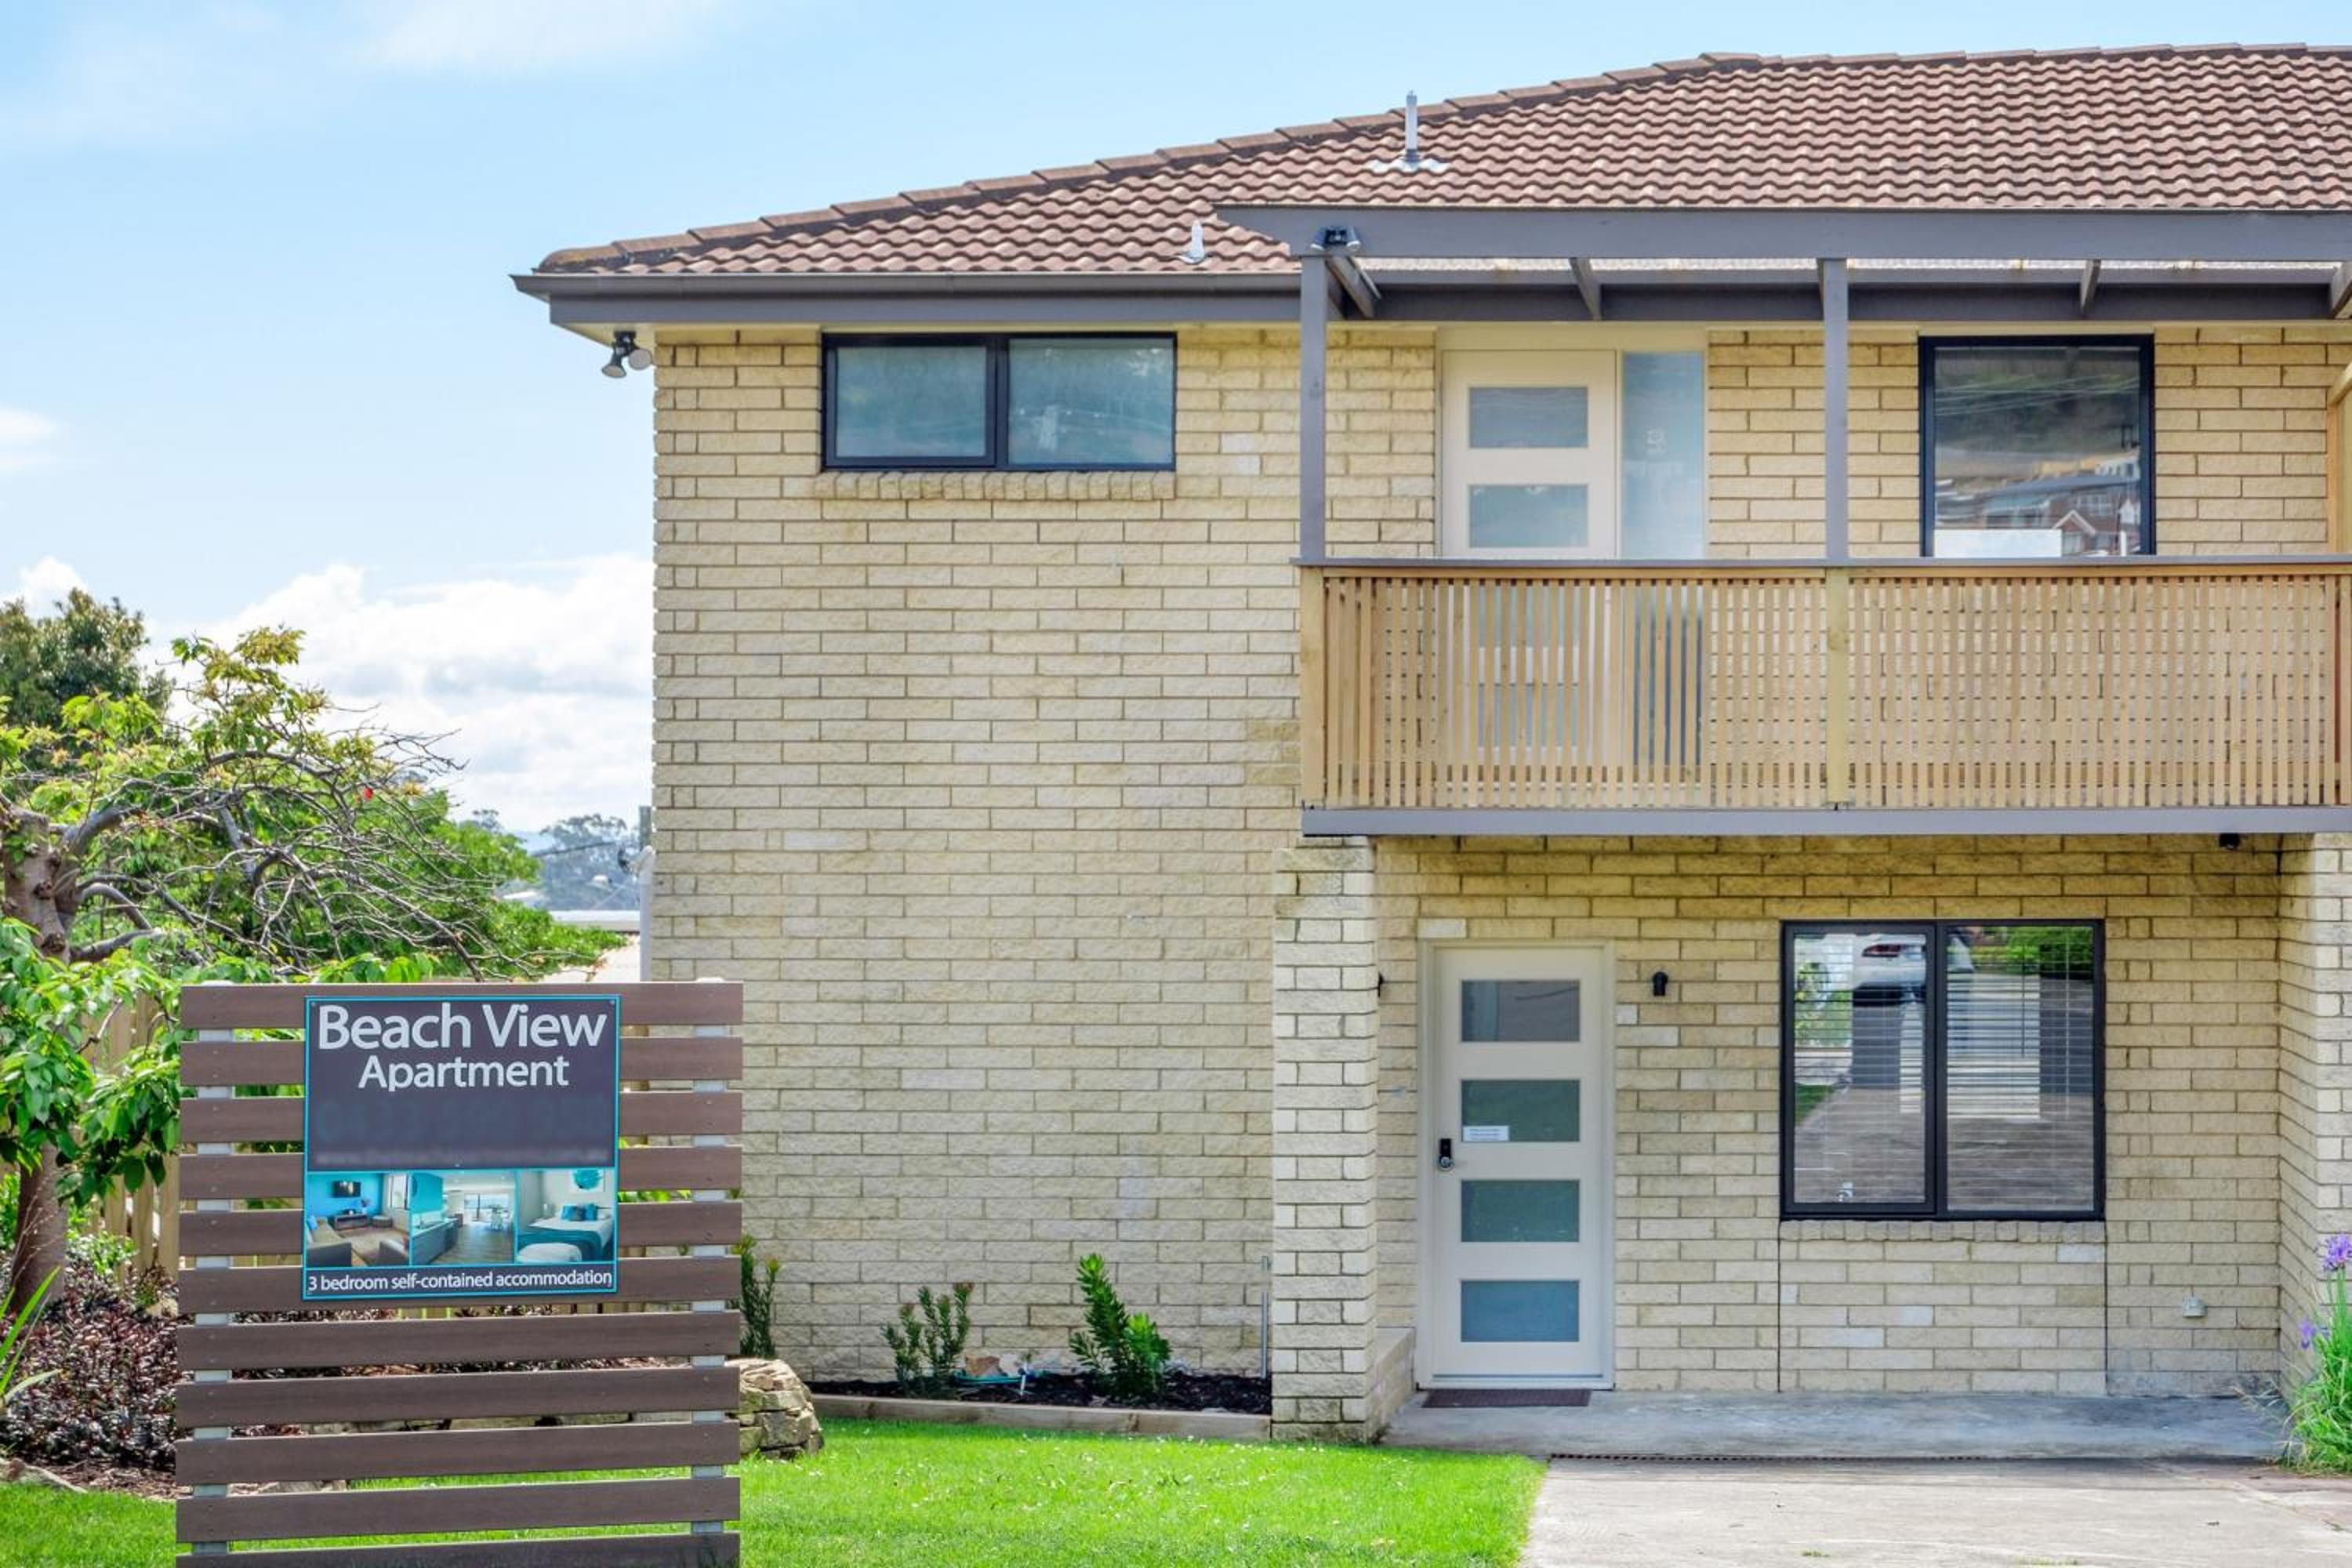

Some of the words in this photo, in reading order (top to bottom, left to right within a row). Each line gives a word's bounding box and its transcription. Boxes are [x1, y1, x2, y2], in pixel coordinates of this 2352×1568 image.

[318, 1002, 471, 1050] Beach
[481, 1004, 608, 1047] View
[358, 1054, 570, 1092] Apartment
[308, 1276, 318, 1291] 3
[321, 1275, 389, 1290] bedroom
[391, 1272, 493, 1290] self-contained
[495, 1269, 612, 1288] accommodation
